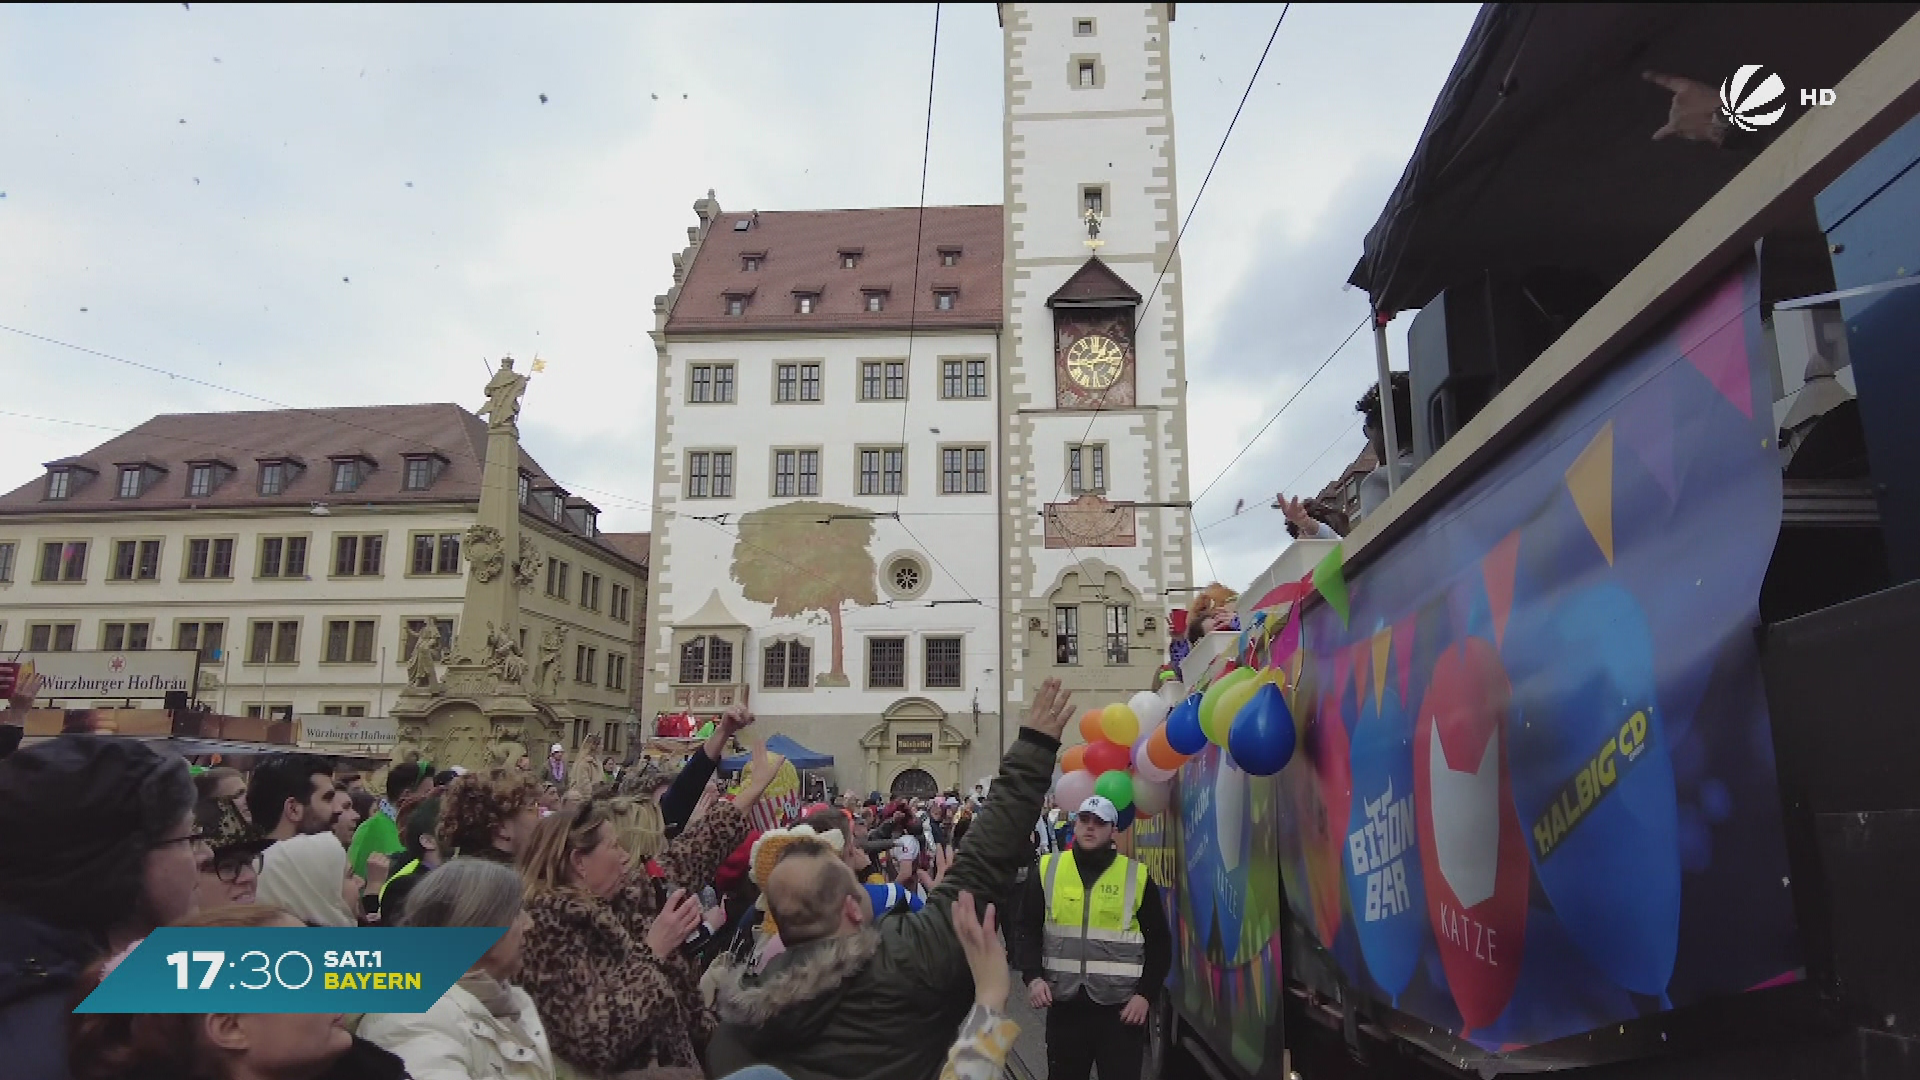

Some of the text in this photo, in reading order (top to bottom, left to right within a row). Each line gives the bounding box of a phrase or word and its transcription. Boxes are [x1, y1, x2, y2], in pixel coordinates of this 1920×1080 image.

[40, 674, 187, 695] Würzburger Hofbräu
[1532, 737, 1617, 857] HALBIG
[1100, 884, 1120, 896] 182
[1364, 858, 1412, 923] BAR
[1439, 901, 1498, 966] KATZE
